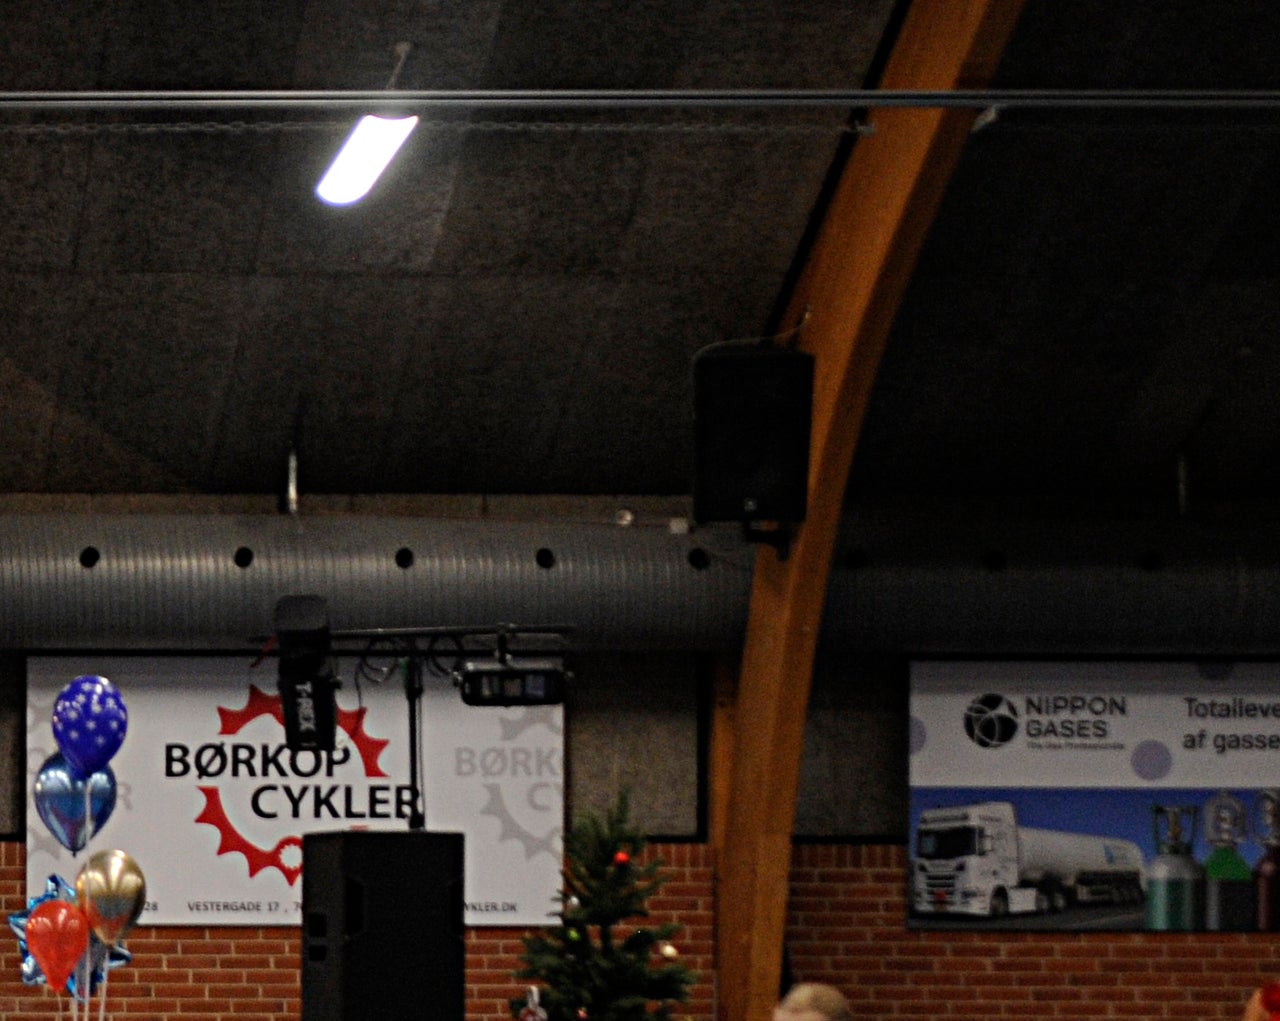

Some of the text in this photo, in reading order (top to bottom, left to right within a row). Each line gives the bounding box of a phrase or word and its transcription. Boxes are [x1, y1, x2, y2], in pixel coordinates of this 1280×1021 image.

[1025, 696, 1127, 715] NIPPON
[1026, 719, 1108, 738] GASES
[1183, 730, 1206, 749] af
[188, 901, 261, 911] VESTERGADE
